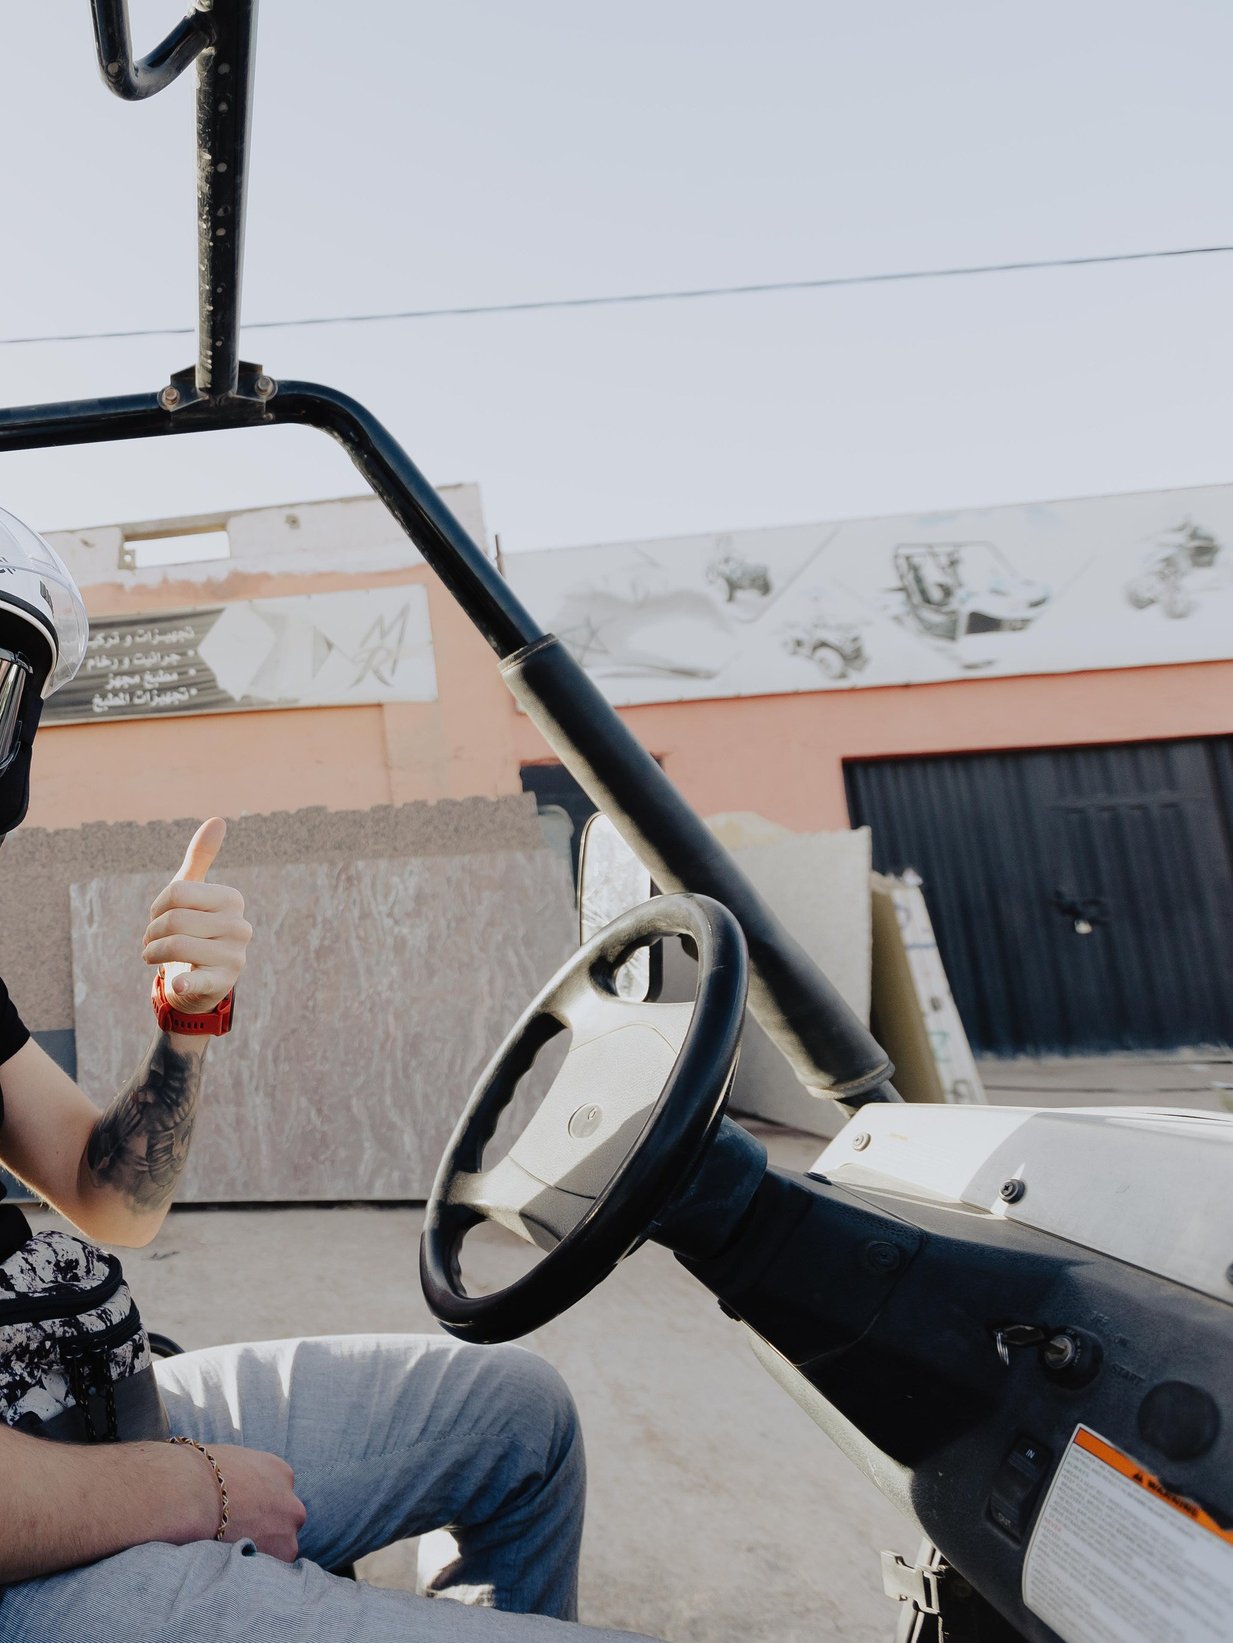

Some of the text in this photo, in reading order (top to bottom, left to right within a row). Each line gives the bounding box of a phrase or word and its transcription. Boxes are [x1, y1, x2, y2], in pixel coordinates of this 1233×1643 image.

[1025, 1448, 1036, 1459] IN
[1066, 1459, 1090, 1478] ALWAYS
[1042, 1517, 1062, 1533] NEVER
